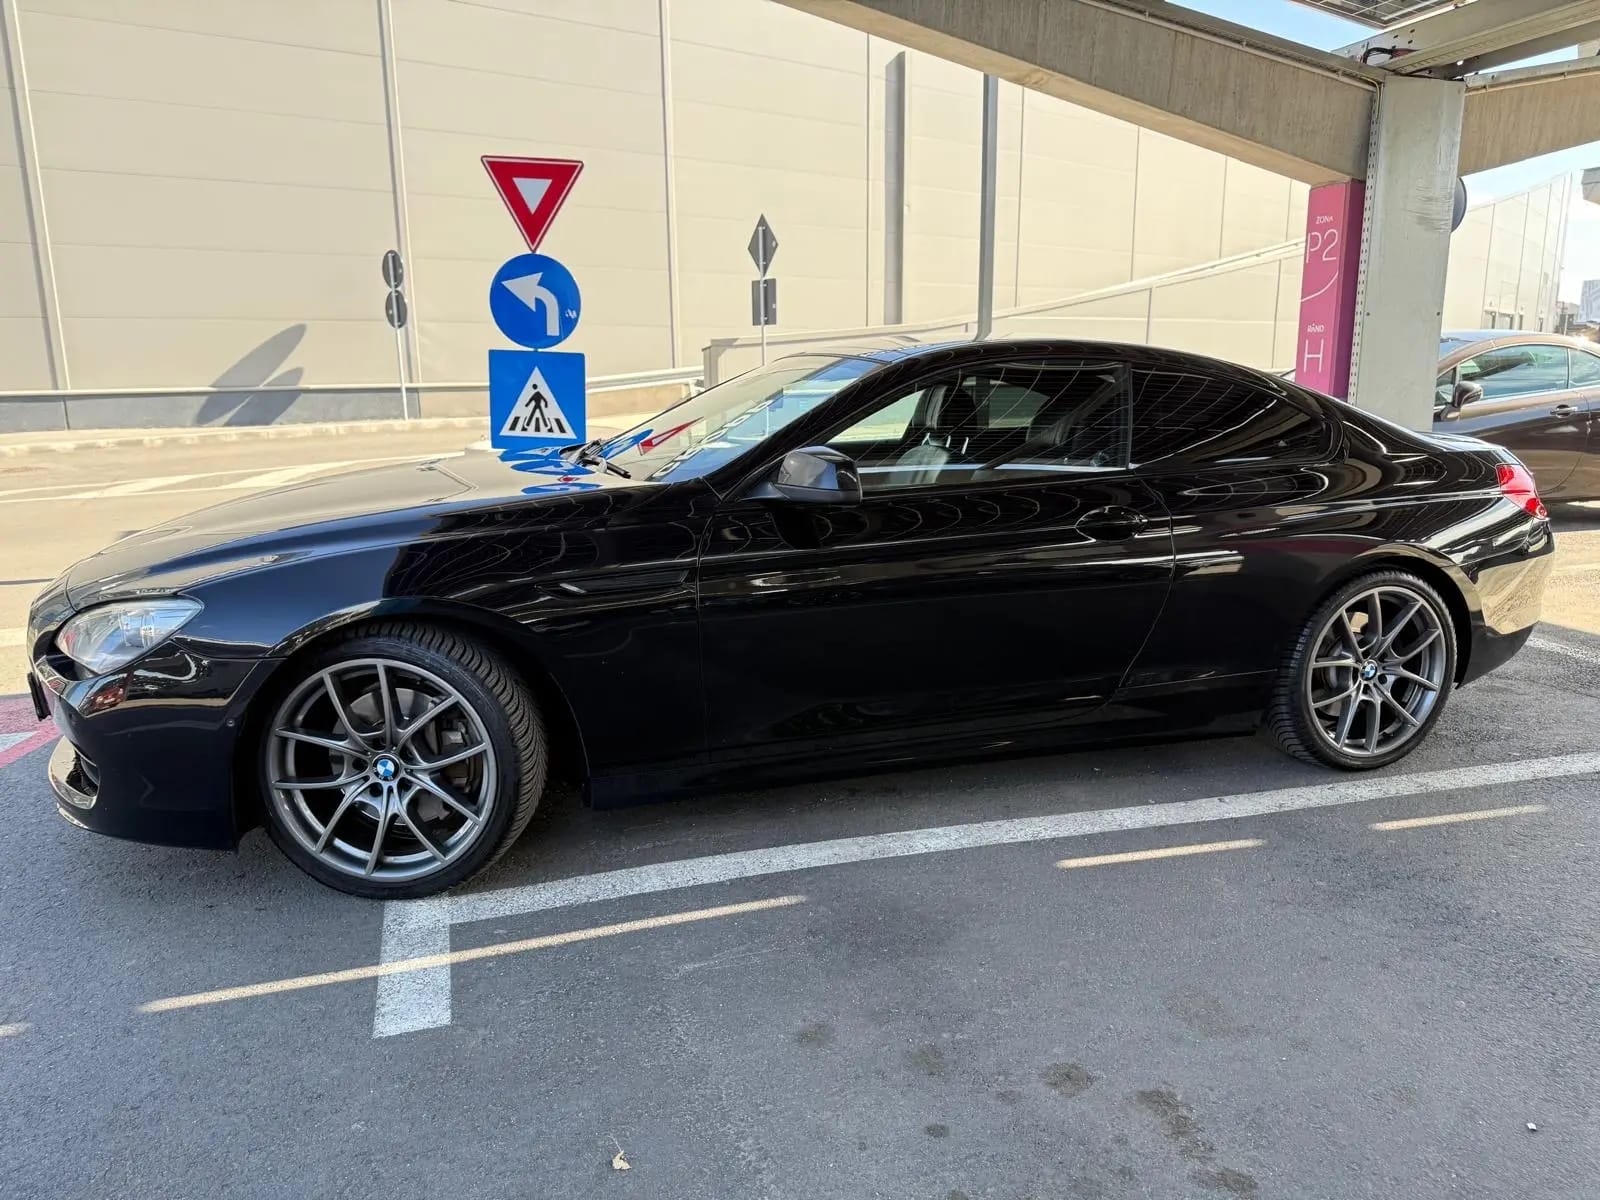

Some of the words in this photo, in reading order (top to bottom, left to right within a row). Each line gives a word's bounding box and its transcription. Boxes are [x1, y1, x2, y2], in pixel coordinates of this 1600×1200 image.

[1316, 216, 1334, 225] ZONA
[1306, 228, 1338, 263] P2
[1304, 339, 1324, 373] H
